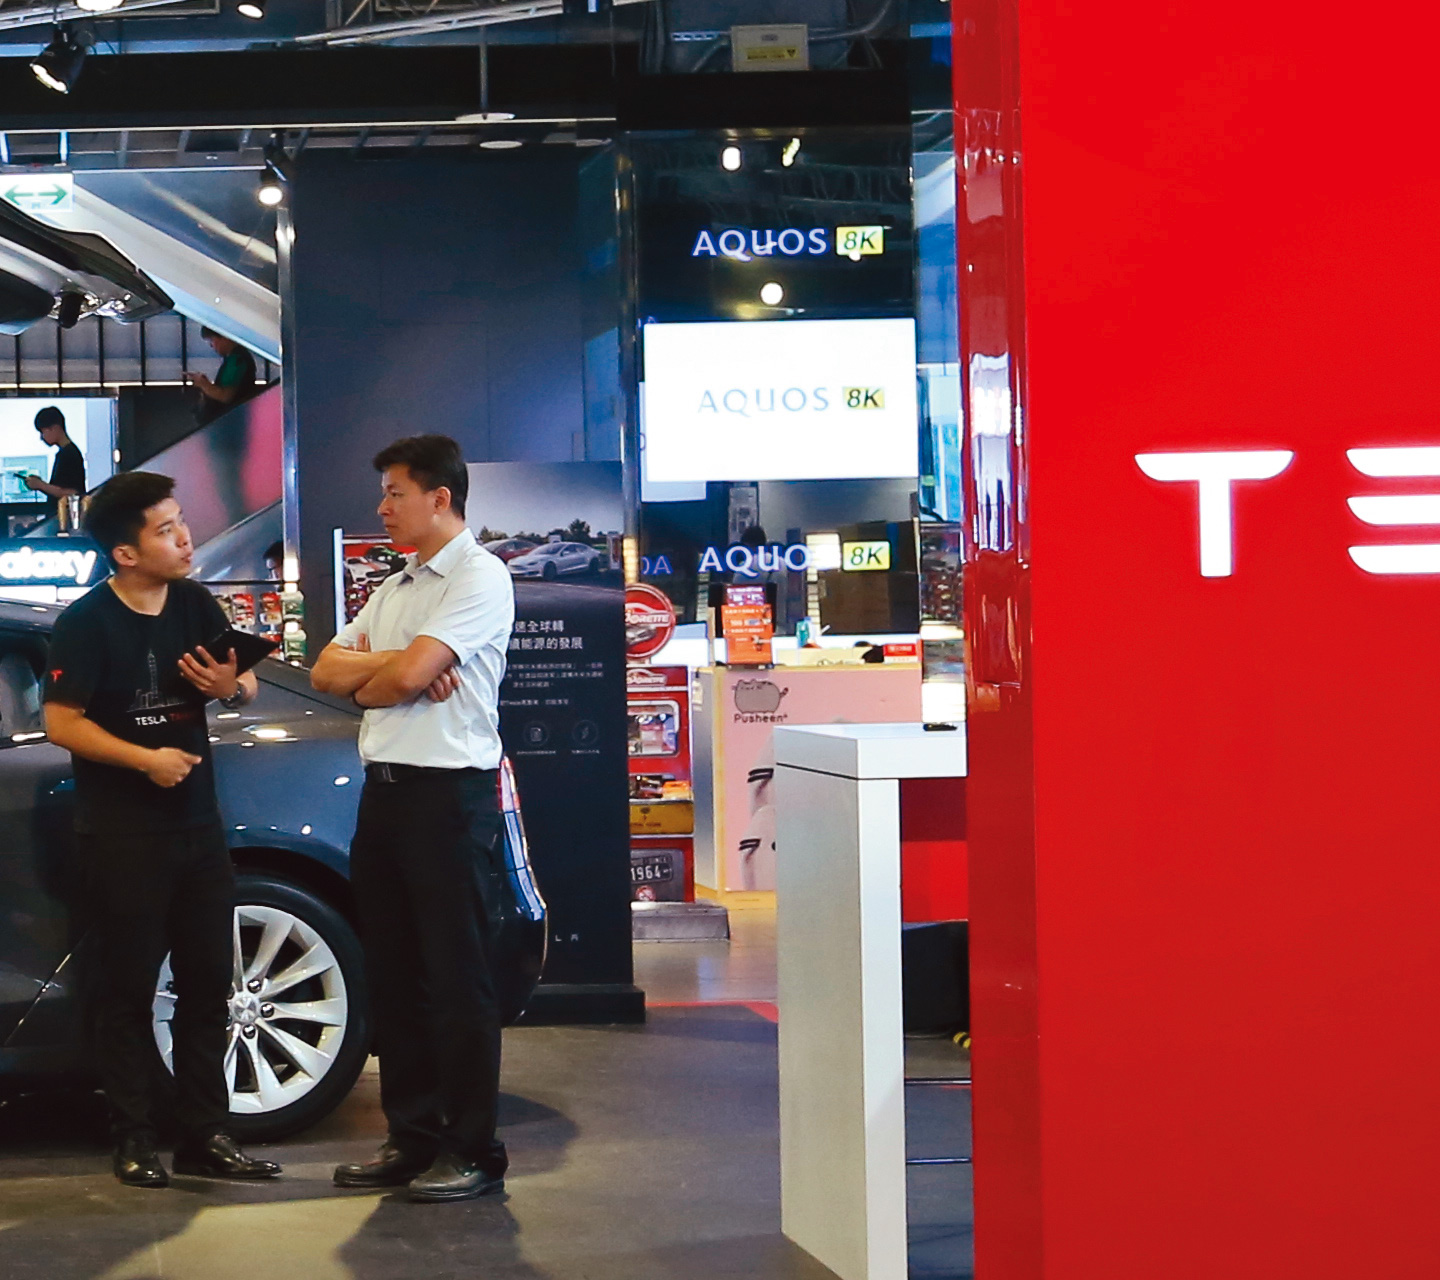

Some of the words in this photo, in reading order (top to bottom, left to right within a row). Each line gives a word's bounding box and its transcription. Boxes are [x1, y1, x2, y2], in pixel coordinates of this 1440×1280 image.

[692, 227, 827, 261] AQUOS
[697, 387, 829, 417] AQUOS
[847, 388, 882, 409] 8K
[699, 544, 812, 577] AQUO
[849, 546, 883, 568] 8K
[135, 715, 168, 726] TESLA
[631, 865, 661, 881] 1964
